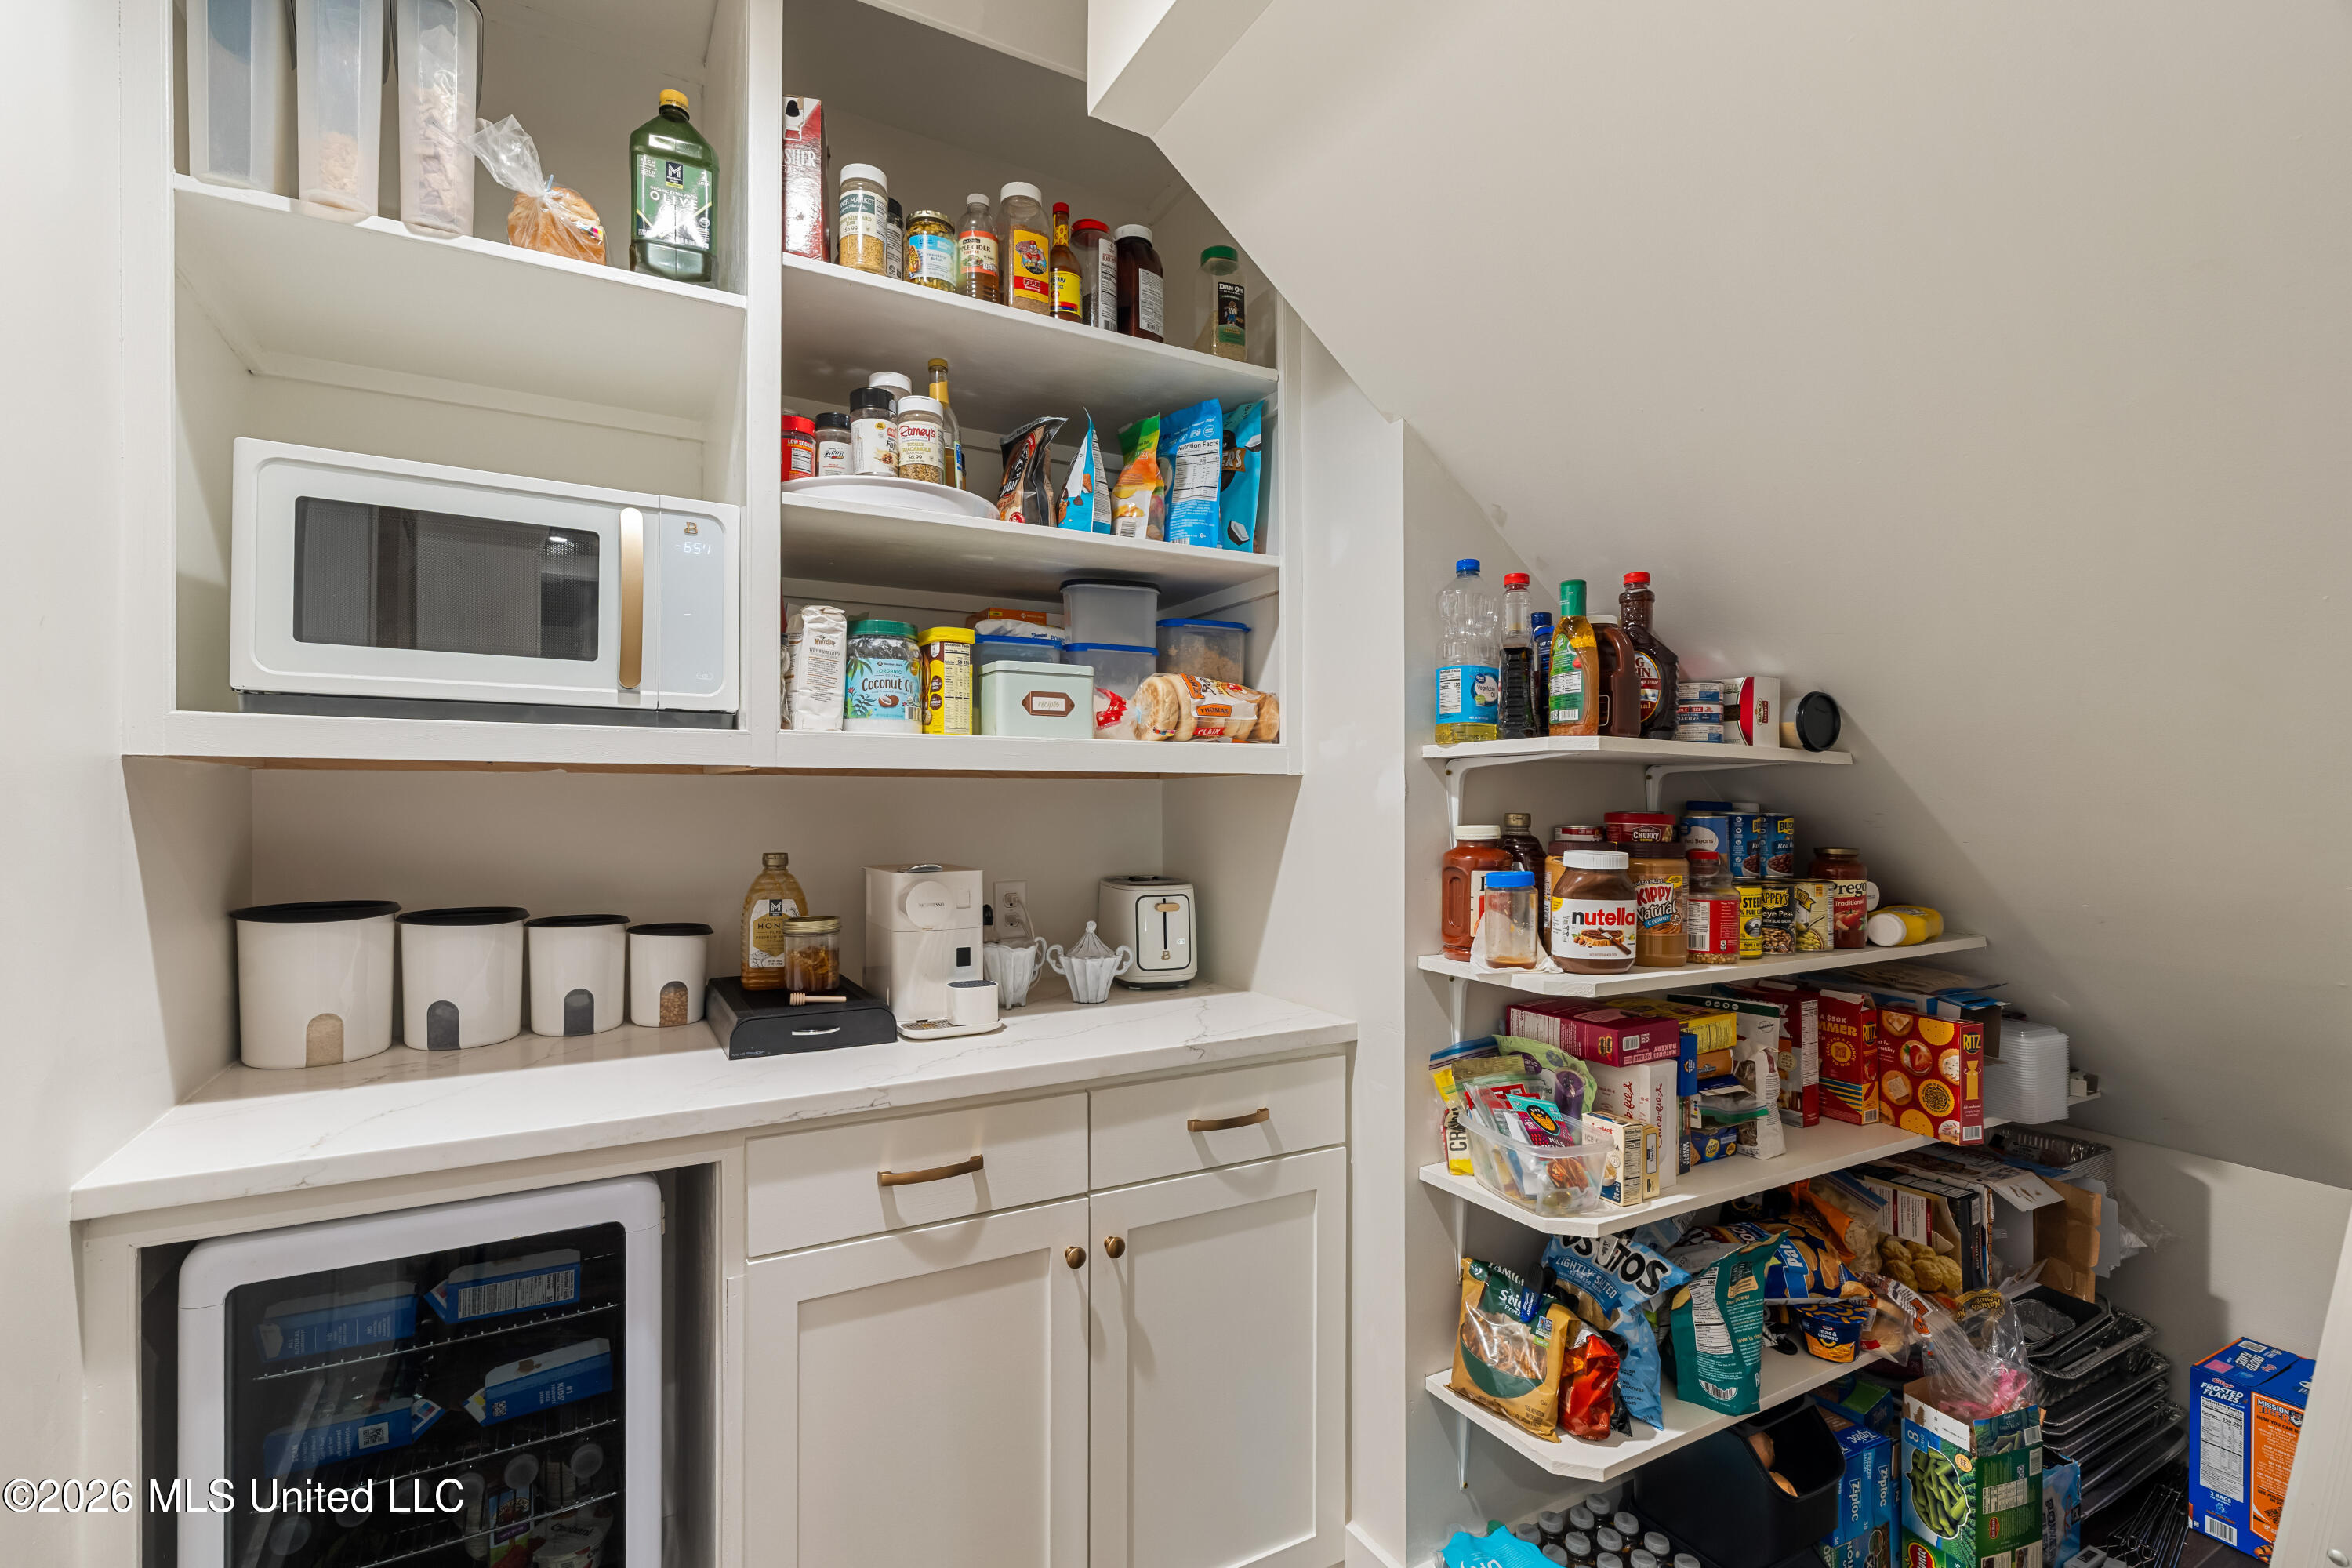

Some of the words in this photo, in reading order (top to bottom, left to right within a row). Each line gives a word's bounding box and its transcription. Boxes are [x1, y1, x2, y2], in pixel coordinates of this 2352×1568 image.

[649, 190, 699, 210] OLIVE
[850, 195, 876, 207] MARKET
[844, 225, 859, 234] $6.99
[971, 244, 992, 253] CIDER
[1218, 283, 1244, 294] DAN-O'S
[899, 425, 936, 441] Ramey's
[1178, 442, 1201, 452] Nutrition
[1635, 657, 1645, 667] G
[862, 677, 903, 692] Coconut
[904, 679, 915, 695] Oil
[1477, 684, 1496, 693] Vegetable
[1037, 699, 1061, 710] recipes
[1632, 831, 1660, 841] CHUNKY
[1635, 886, 1671, 906] KIPPY
[1834, 898, 1864, 907] Traditional
[1572, 907, 1635, 926] nutella
[1636, 898, 1678, 923] Natural
[1779, 909, 1794, 918] Peas
[1646, 915, 1670, 927] Creamy
[1826, 1014, 1847, 1024] $50K
[1862, 1022, 1877, 1043] RITZ
[1653, 1042, 1677, 1053] BAKERY
[1962, 1033, 1982, 1051] RITZ
[1548, 1137, 1566, 1149] MILD
[1555, 1256, 1596, 1279] LIGHTLY
[1594, 1274, 1618, 1300] SALTED
[1817, 1332, 1838, 1341] cheese
[2212, 1377, 2234, 1388] Kellogg's
[557, 1381, 565, 1402] KIDS'
[2200, 1381, 2244, 1399] FROSTED
[2202, 1388, 2241, 1403] FLAKES
[2201, 1397, 2227, 1409] Nutrition
[2227, 1406, 2244, 1415] Facts
[2257, 1398, 2289, 1415] MISSION
[2256, 1414, 2270, 1423] HOW
[2270, 1419, 2281, 1428] YOU
[2281, 1424, 2294, 1433] CAN
[1907, 1429, 1919, 1443] 8
[1878, 1465, 1889, 1508] Ziploc
[1849, 1478, 1861, 1522] Ziploc
[2215, 1491, 2231, 1504] BAGS
